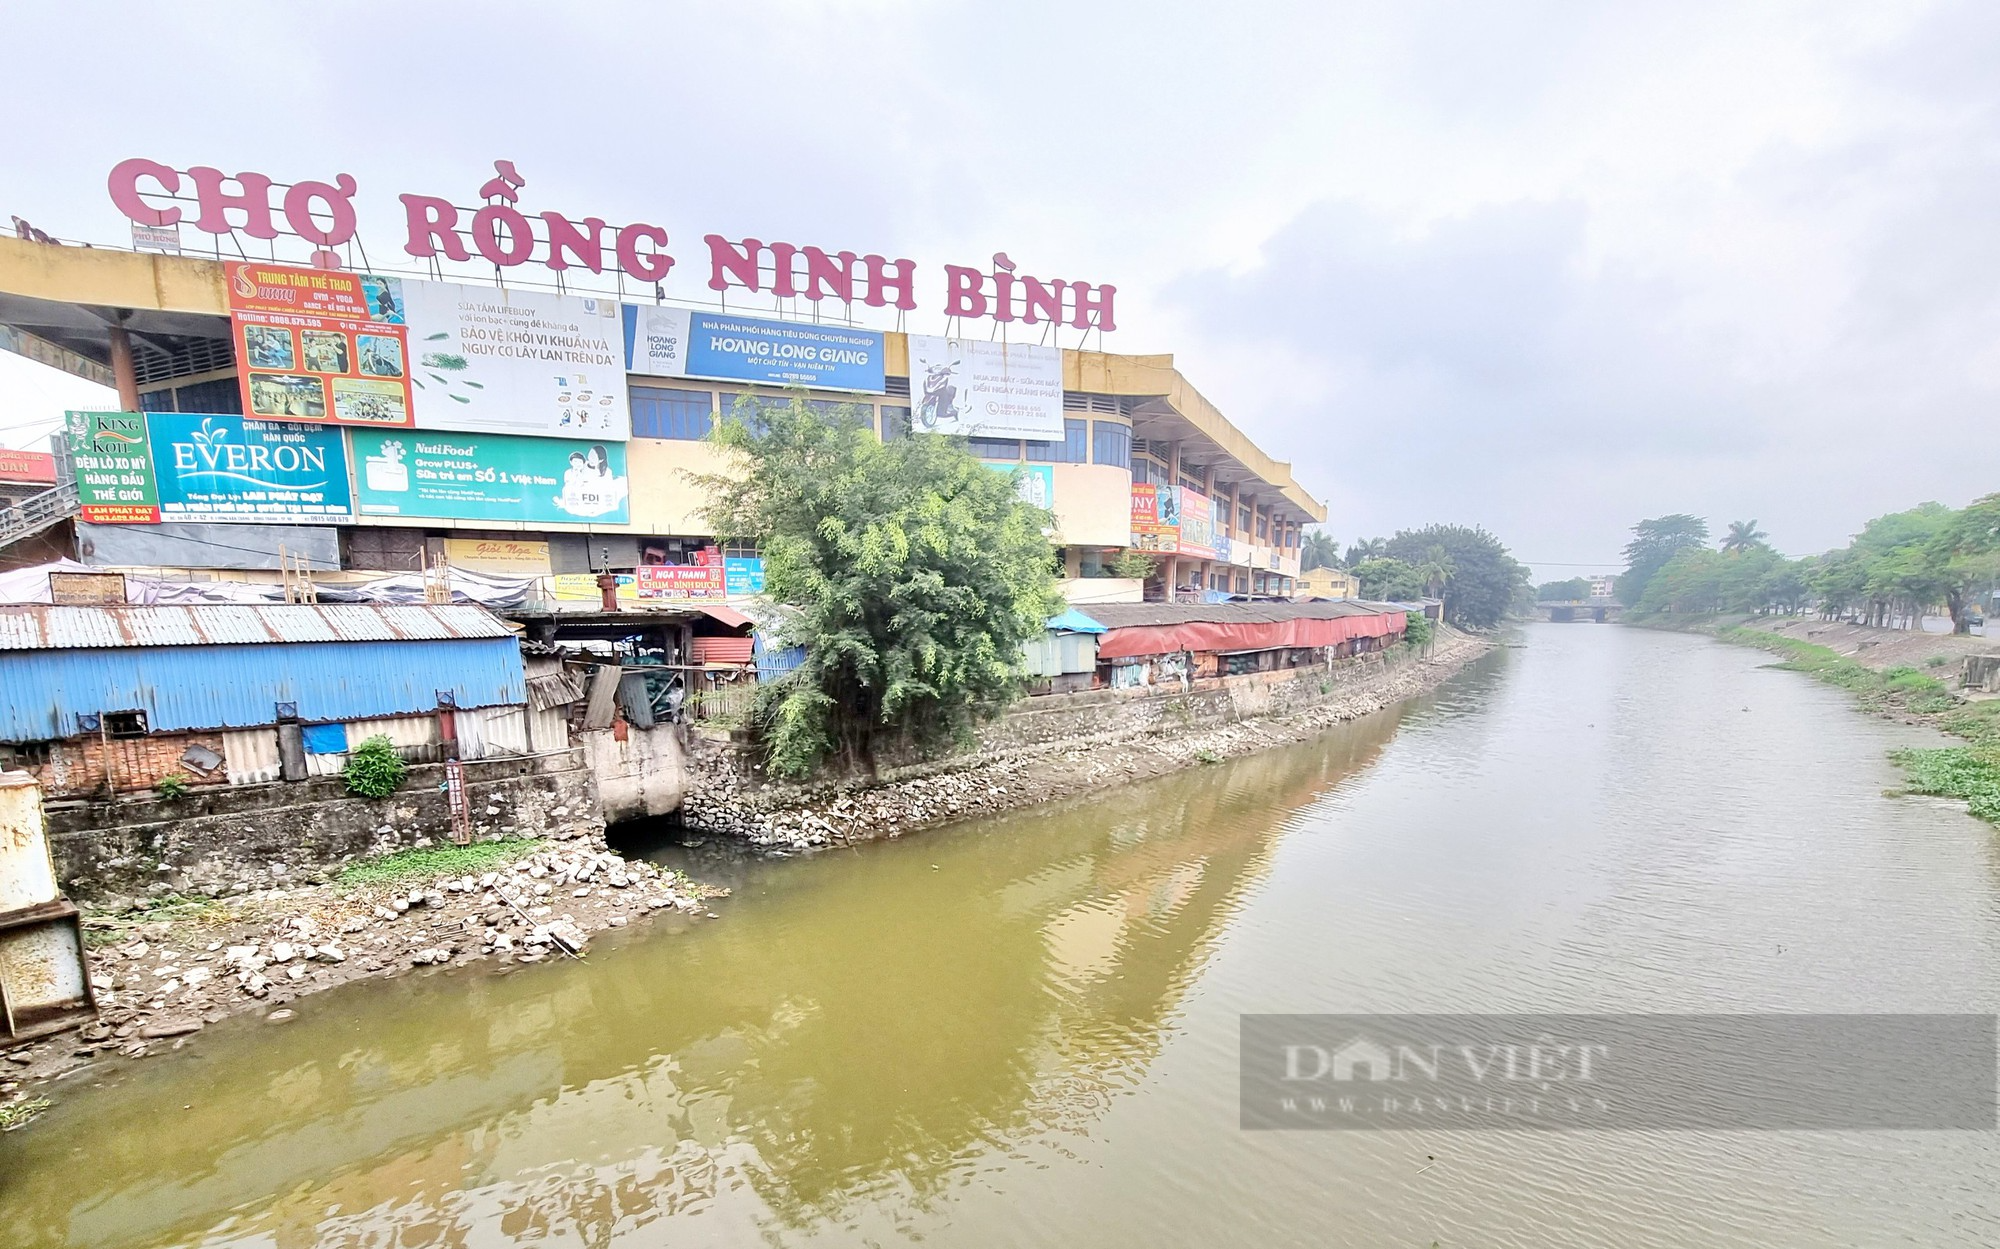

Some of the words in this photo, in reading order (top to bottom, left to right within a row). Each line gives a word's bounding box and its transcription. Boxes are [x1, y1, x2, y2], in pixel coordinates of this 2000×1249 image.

[107, 158, 357, 270] CHỢ
[399, 160, 675, 282] RỒNG
[703, 234, 917, 310] NINH
[944, 253, 1117, 332] BÌNH
[256, 271, 288, 286] TRUNG
[289, 271, 309, 287] TÂM
[311, 274, 328, 290] THỂ
[330, 278, 352, 292] THAO
[336, 294, 354, 304] YOGA
[304, 302, 322, 310] DANCE
[497, 306, 536, 318] LIFEBUOY
[237, 312, 268, 323] Hotline:
[474, 315, 488, 323] ion
[568, 322, 578, 332] da
[460, 326, 487, 340] BẢO
[488, 328, 504, 342] VỆ
[506, 328, 534, 344] KHỎI
[536, 332, 548, 346] VI
[550, 331, 591, 350] KHUẨN
[592, 336, 609, 352] VÀ
[702, 320, 719, 331] NHÀ
[720, 322, 741, 332] PHÂN
[742, 323, 760, 335] PHỐI
[760, 325, 782, 337] HÀNG
[782, 328, 799, 338] TIÊU
[800, 330, 820, 342] DÙNG
[820, 332, 848, 344] CHUYÊN
[848, 335, 874, 348] NGHIỆP
[462, 342, 496, 356] NGUY
[498, 344, 514, 357] CƠ
[516, 344, 539, 359] LÂY
[540, 348, 563, 361] LAN
[565, 349, 596, 364] TRÊN
[650, 342, 674, 352] LONG
[648, 350, 676, 360] GIANG
[772, 342, 820, 360] LONG
[820, 346, 868, 366] GIANG
[747, 356, 762, 366] MỘT
[263, 432, 282, 443] HÀN
[283, 432, 306, 444] QUỐC
[414, 442, 474, 457] NutiFood
[76, 454, 99, 472] ĐỆM
[100, 454, 115, 470] LÒ
[116, 458, 130, 470] XO
[172, 443, 326, 472] EVERON
[414, 459, 443, 470] Grow
[444, 460, 479, 471] PLUS+
[84, 471, 118, 486] HÀNG
[122, 470, 145, 486] ĐẦU
[416, 468, 438, 480] Sữa
[458, 473, 474, 482] em
[474, 467, 495, 482] SỐ
[499, 471, 508, 482] 1
[510, 474, 533, 486] Việt
[534, 476, 557, 486] Nam
[92, 486, 117, 500] THẾ
[118, 488, 144, 500] GIỚI
[242, 492, 266, 501] LAN
[582, 494, 600, 502] FDI
[505, 544, 532, 557] Nga
[655, 570, 675, 579] NGA
[676, 570, 707, 580] THANH
[642, 580, 668, 590] CHUM
[674, 580, 694, 590] BÌNH
